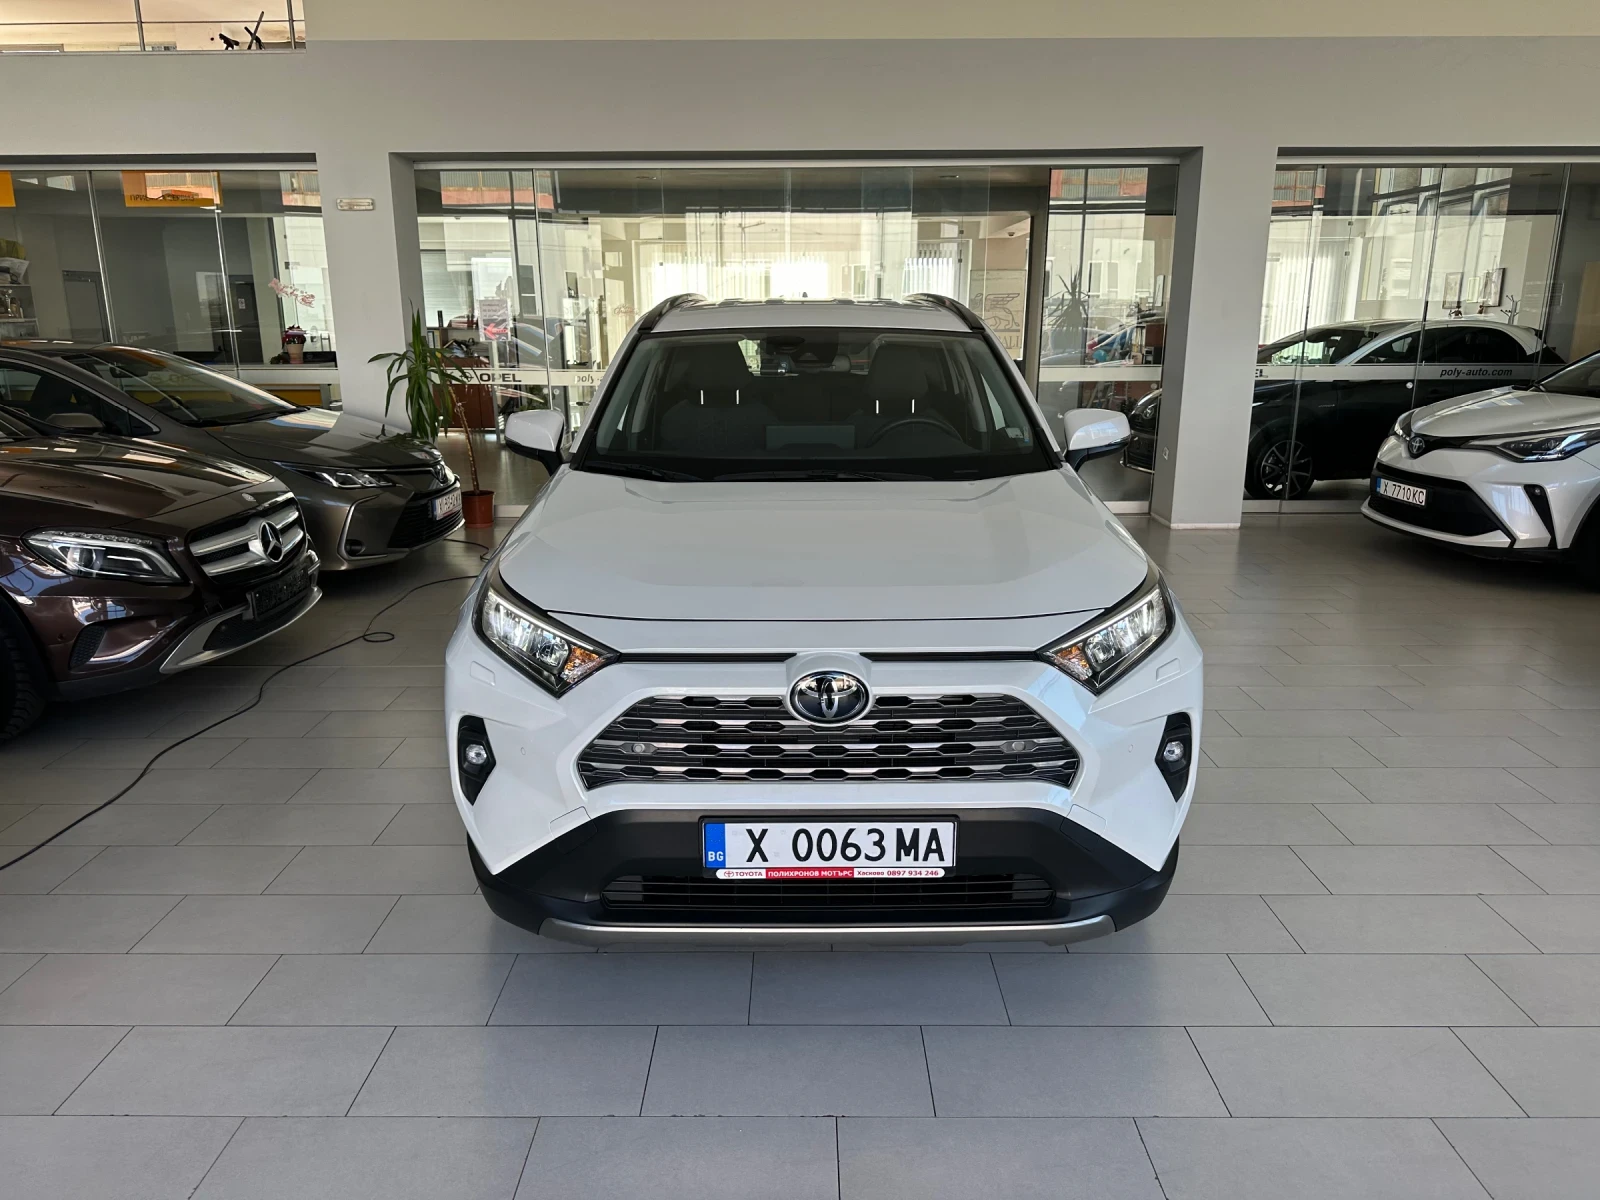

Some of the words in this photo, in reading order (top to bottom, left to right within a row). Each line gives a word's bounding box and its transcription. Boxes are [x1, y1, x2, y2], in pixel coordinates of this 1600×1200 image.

[479, 372, 522, 383] OPEL
[1440, 367, 1513, 378] poly-auto.com
[745, 828, 769, 863] X
[707, 851, 724, 862] BG
